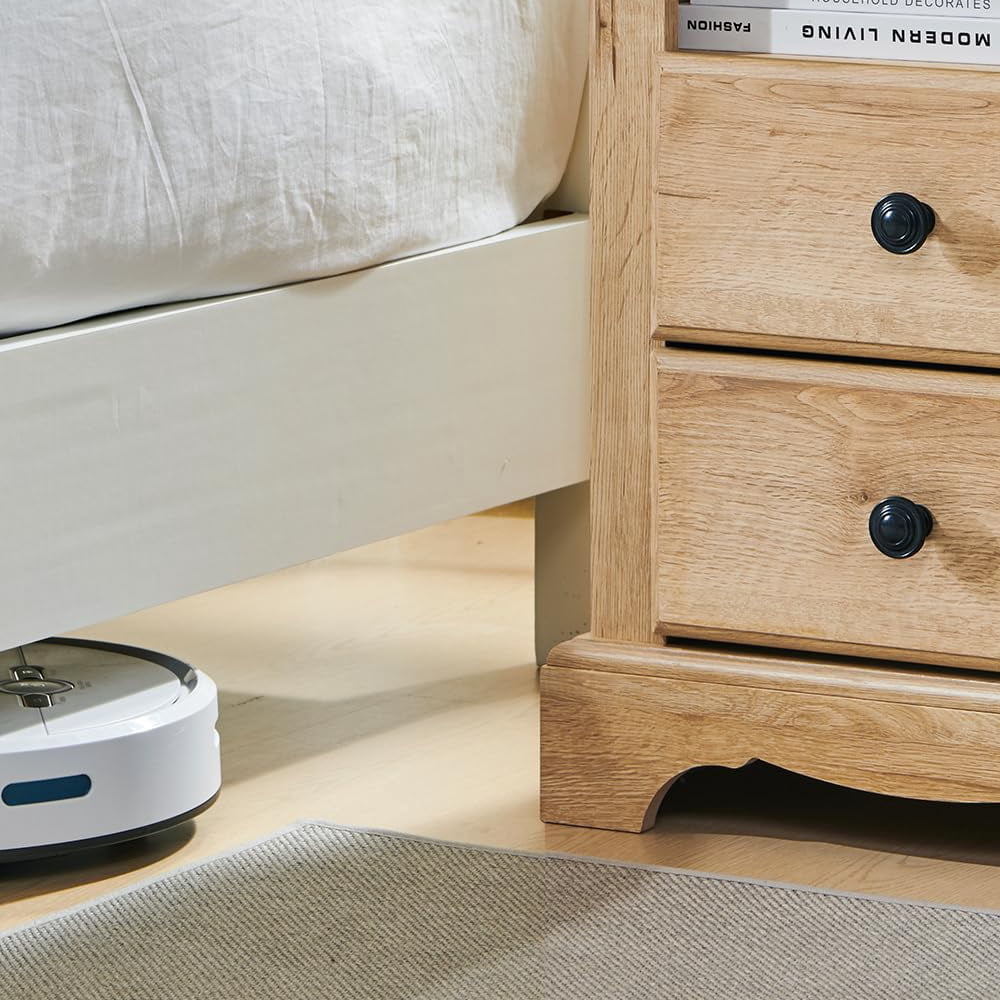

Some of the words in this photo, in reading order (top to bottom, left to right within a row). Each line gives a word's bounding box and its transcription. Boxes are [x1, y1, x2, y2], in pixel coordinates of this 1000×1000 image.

[687, 20, 751, 32] FASHION
[802, 24, 878, 41] LIVING
[892, 29, 991, 47] MODERN
